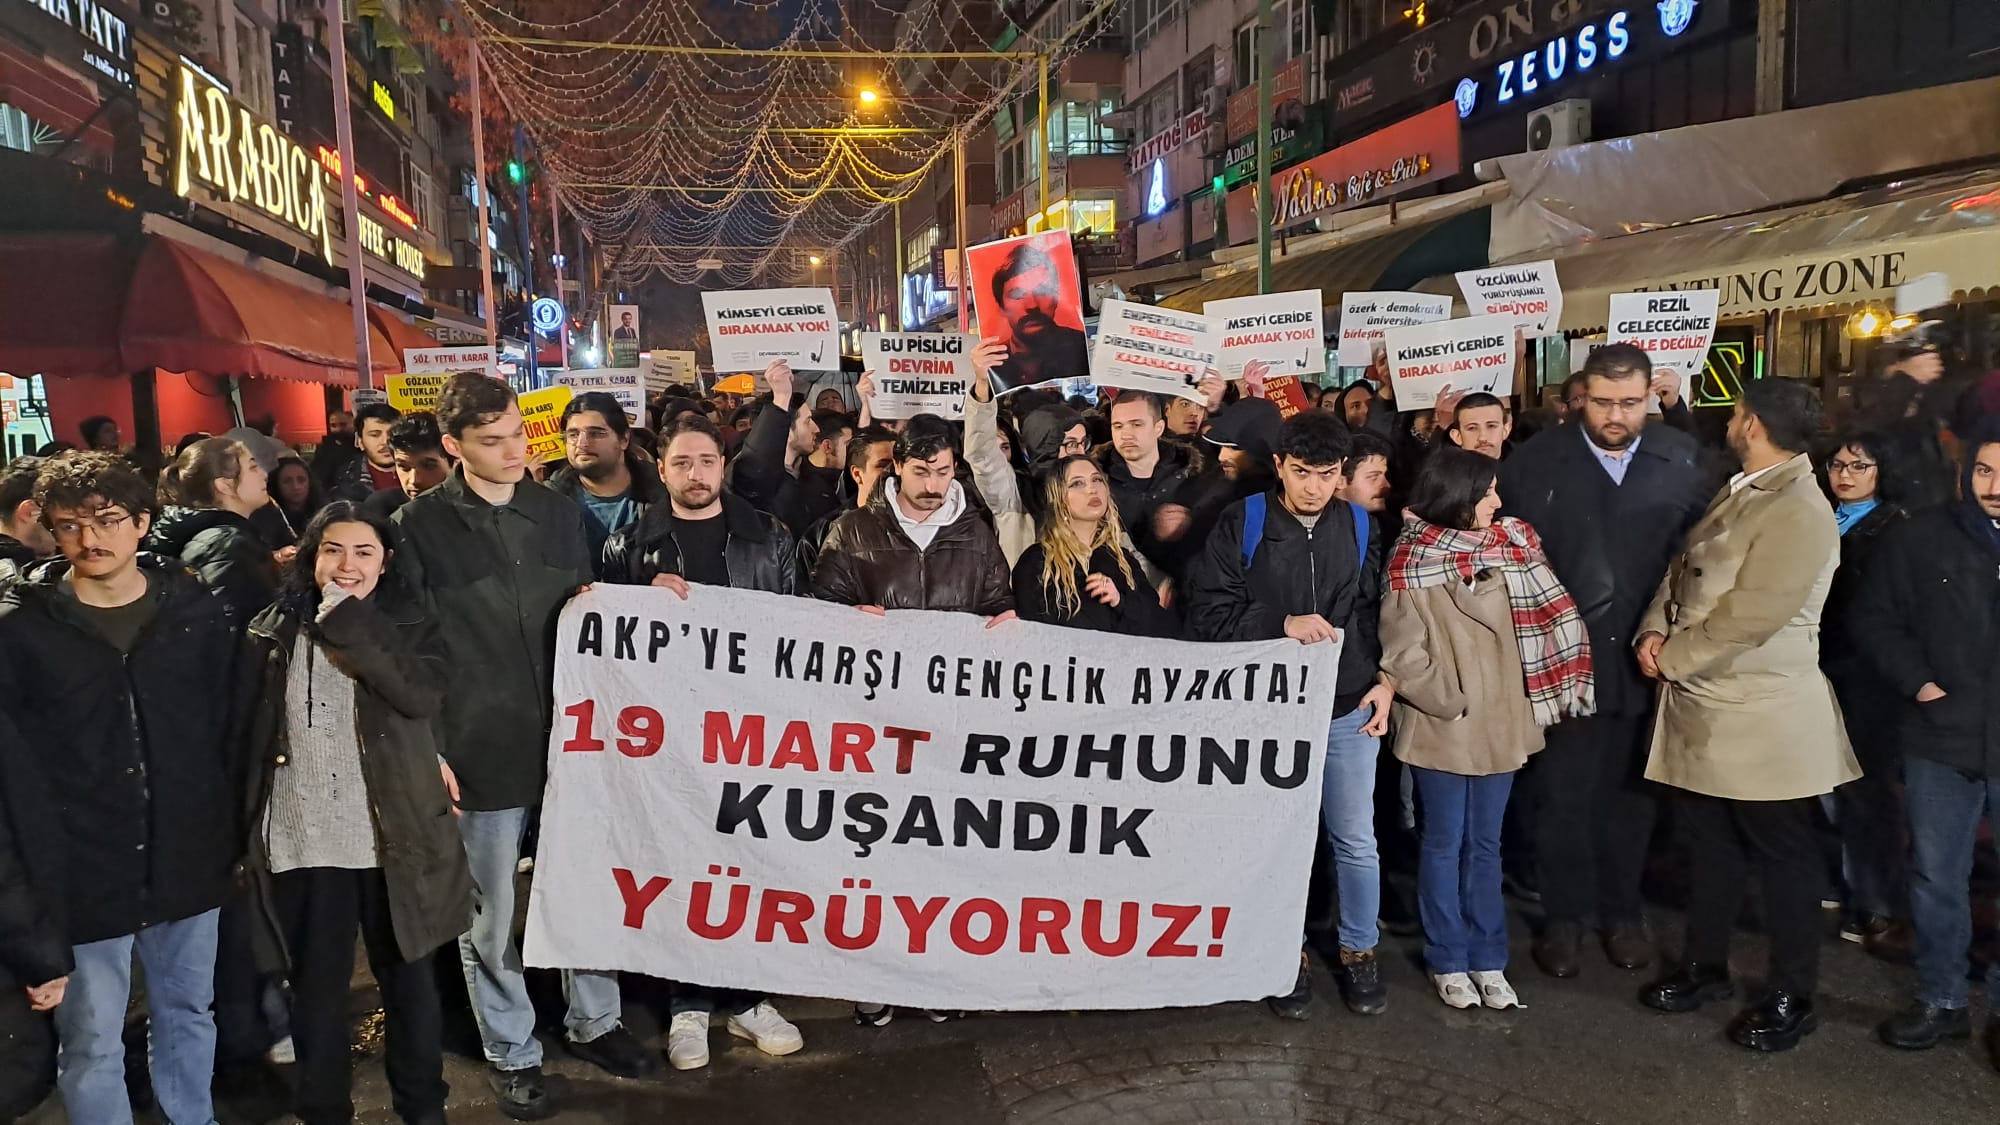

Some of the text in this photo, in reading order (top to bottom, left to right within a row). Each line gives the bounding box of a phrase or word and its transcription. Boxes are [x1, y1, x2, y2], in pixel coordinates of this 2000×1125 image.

[1498, 11, 1629, 102] ZEUSS
[1225, 140, 1255, 168] ADEM
[177, 66, 333, 268] ARABICA
[395, 237, 425, 280] HOUSE
[1476, 270, 1541, 287] ÖZGÜRLÜK
[1794, 251, 1906, 299] ZONE
[717, 304, 826, 319] KİMSEYİ GERİDE
[1349, 304, 1377, 314] özerk
[1648, 294, 1690, 314] REZİL
[719, 319, 830, 336] BIRAKMAK YOK!
[1224, 311, 1313, 330] MSEYİ GERİDE
[1617, 315, 1711, 334] GELECEĞİNİZE
[880, 336, 963, 355] BU PİSLİĞİ
[1222, 327, 1315, 348] IRAKMAK YOK!
[1660, 335, 1707, 352] DEĞİLİZ!
[462, 353, 489, 362] KARAR
[1398, 335, 1505, 361] KİMSEYİ GERİDE
[889, 358, 955, 375] DEVRİM
[1475, 354, 1507, 369] YOK!
[609, 375, 637, 386] KARAR
[881, 379, 966, 396] TEMİZLER!
[1268, 389, 1287, 401] YOK
[577, 612, 1309, 713] AKP'YE KARŞI GENÇLİK AYAKTA!
[562, 699, 1311, 790] 19 MART RUHUNU
[715, 781, 1155, 858] KUŞANDIK
[611, 864, 1232, 959] YÜRÜYORUZ!
